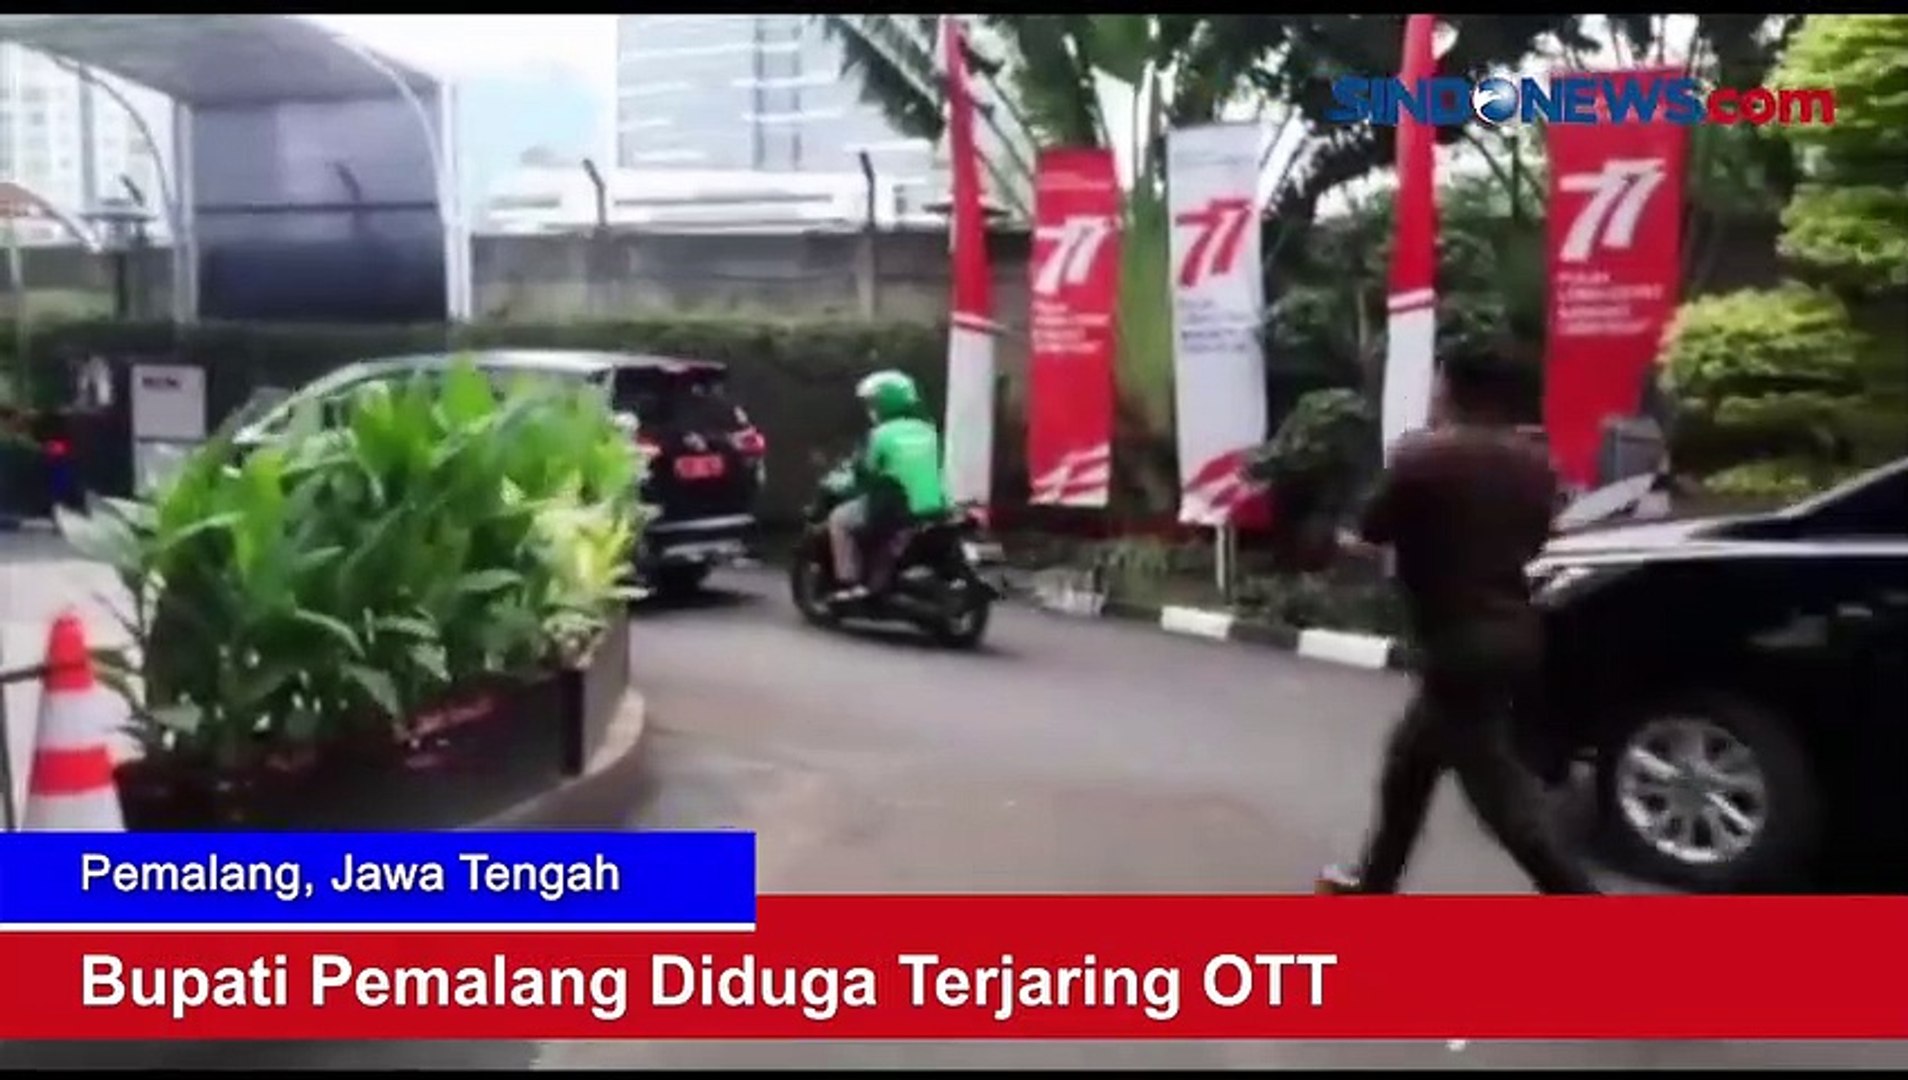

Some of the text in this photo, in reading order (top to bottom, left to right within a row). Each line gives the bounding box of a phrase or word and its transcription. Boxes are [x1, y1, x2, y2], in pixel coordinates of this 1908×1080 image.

[1033, 214, 1113, 294] 77
[1174, 198, 1253, 288] 77
[1560, 157, 1667, 264] 77
